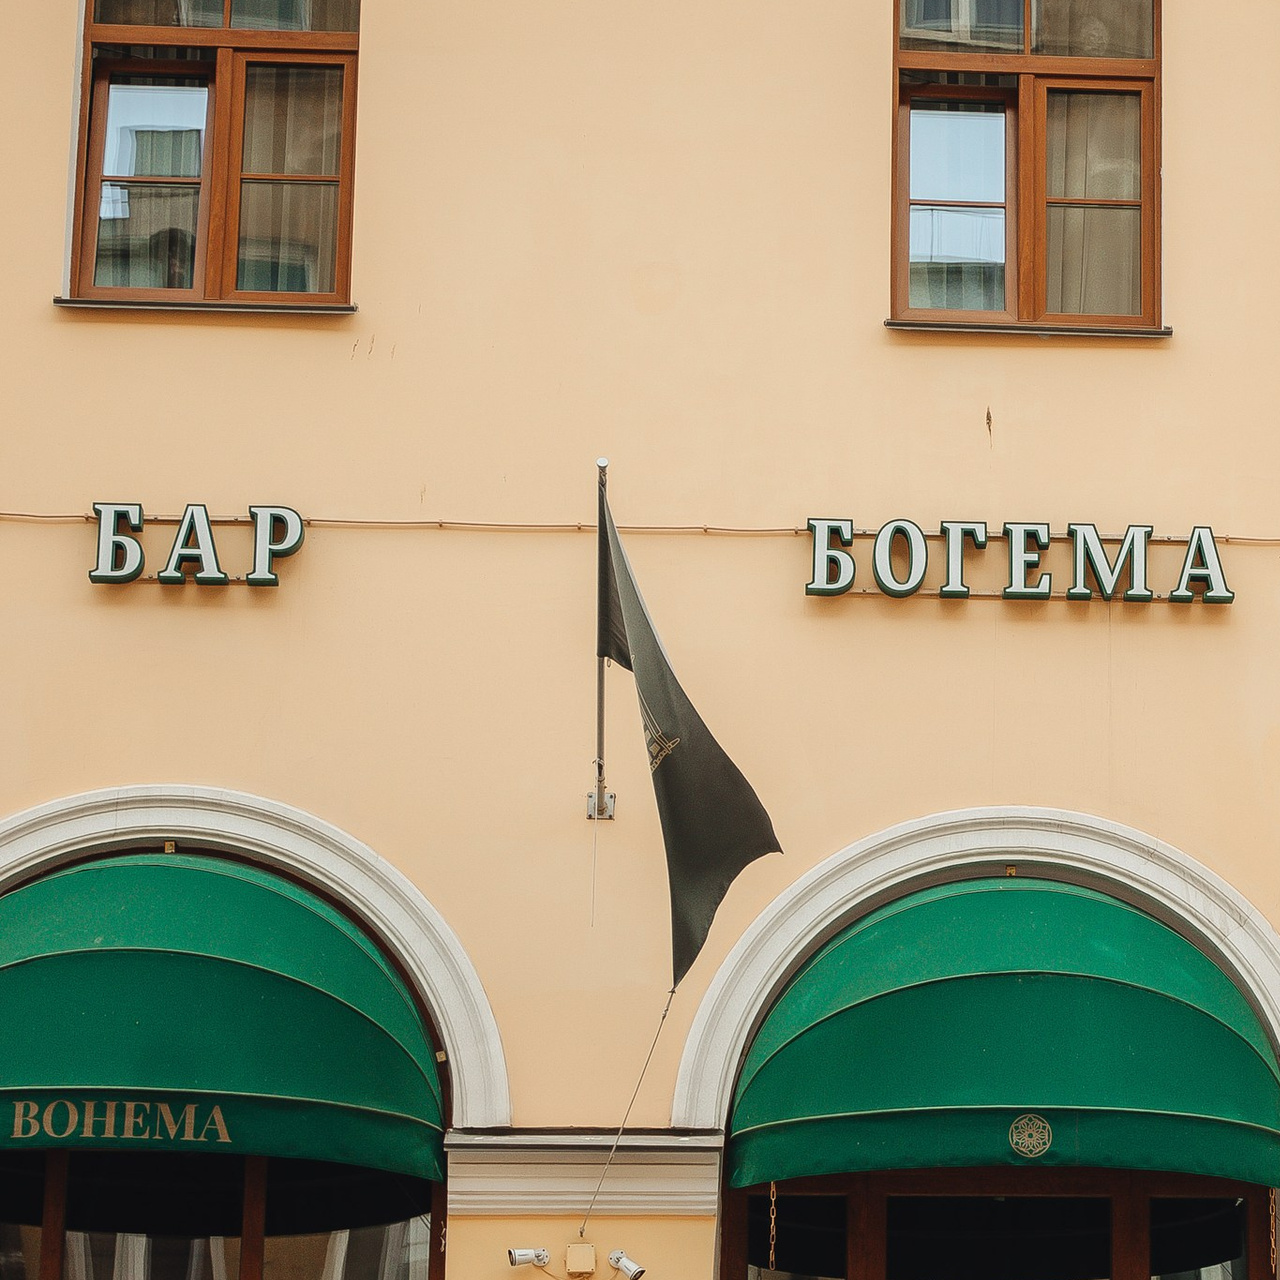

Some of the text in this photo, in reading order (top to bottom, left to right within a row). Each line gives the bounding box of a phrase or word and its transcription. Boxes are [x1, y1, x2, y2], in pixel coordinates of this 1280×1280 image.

[88, 500, 306, 586] БАР
[804, 517, 1236, 604] БОГЕМА
[10, 1099, 233, 1143] BOHEMA
